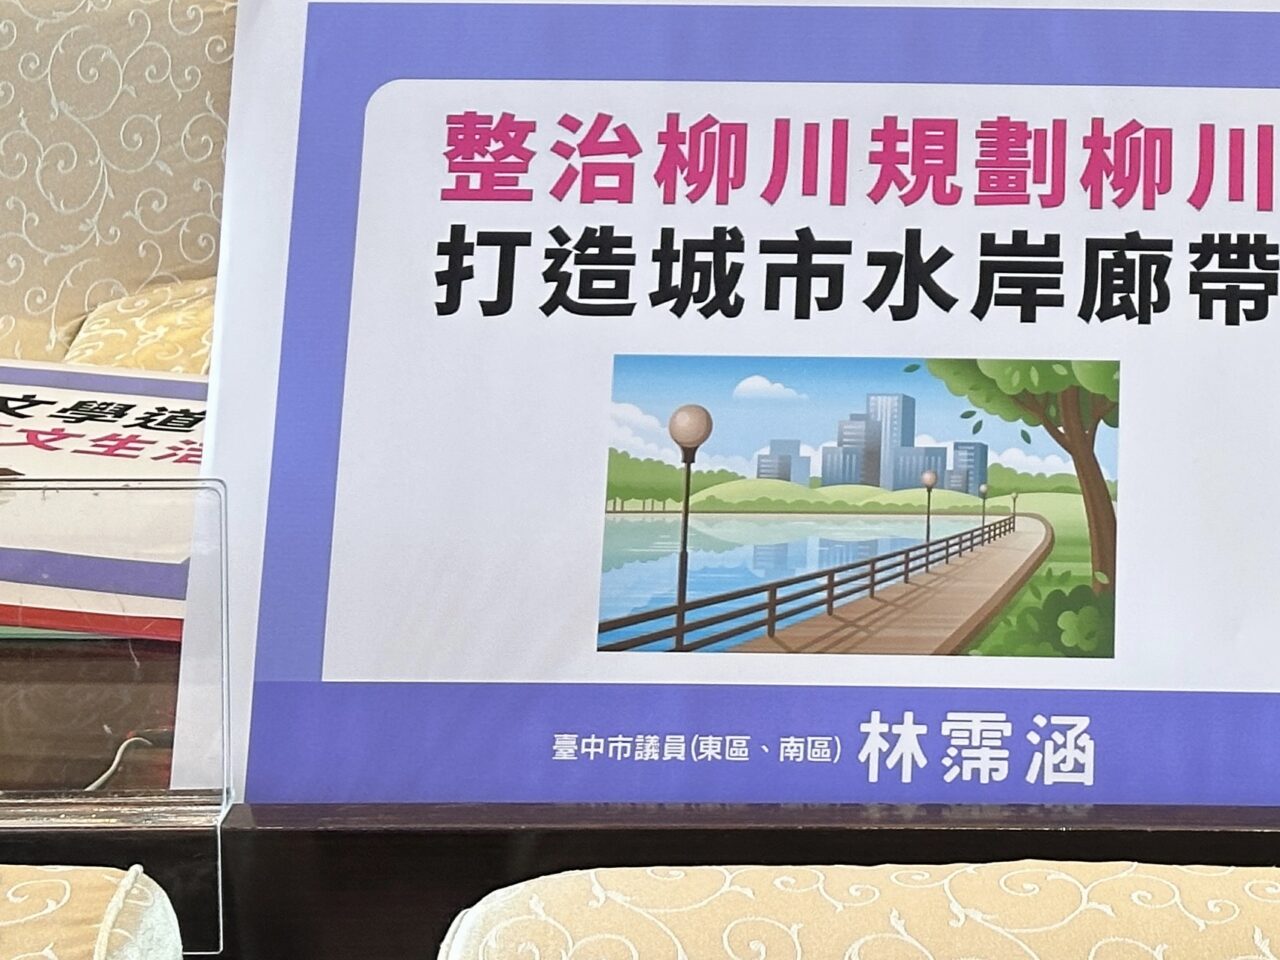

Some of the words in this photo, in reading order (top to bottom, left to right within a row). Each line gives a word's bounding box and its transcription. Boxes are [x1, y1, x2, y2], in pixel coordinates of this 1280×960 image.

[439, 110, 1276, 212] 整治柳川規劃柳川
[434, 224, 1280, 326] 打造城市水岸廊帶
[0, 424, 203, 465] 文生活
[552, 734, 841, 763] 臺中市議員(東區、南區)
[858, 710, 1095, 786] 林霈涵
